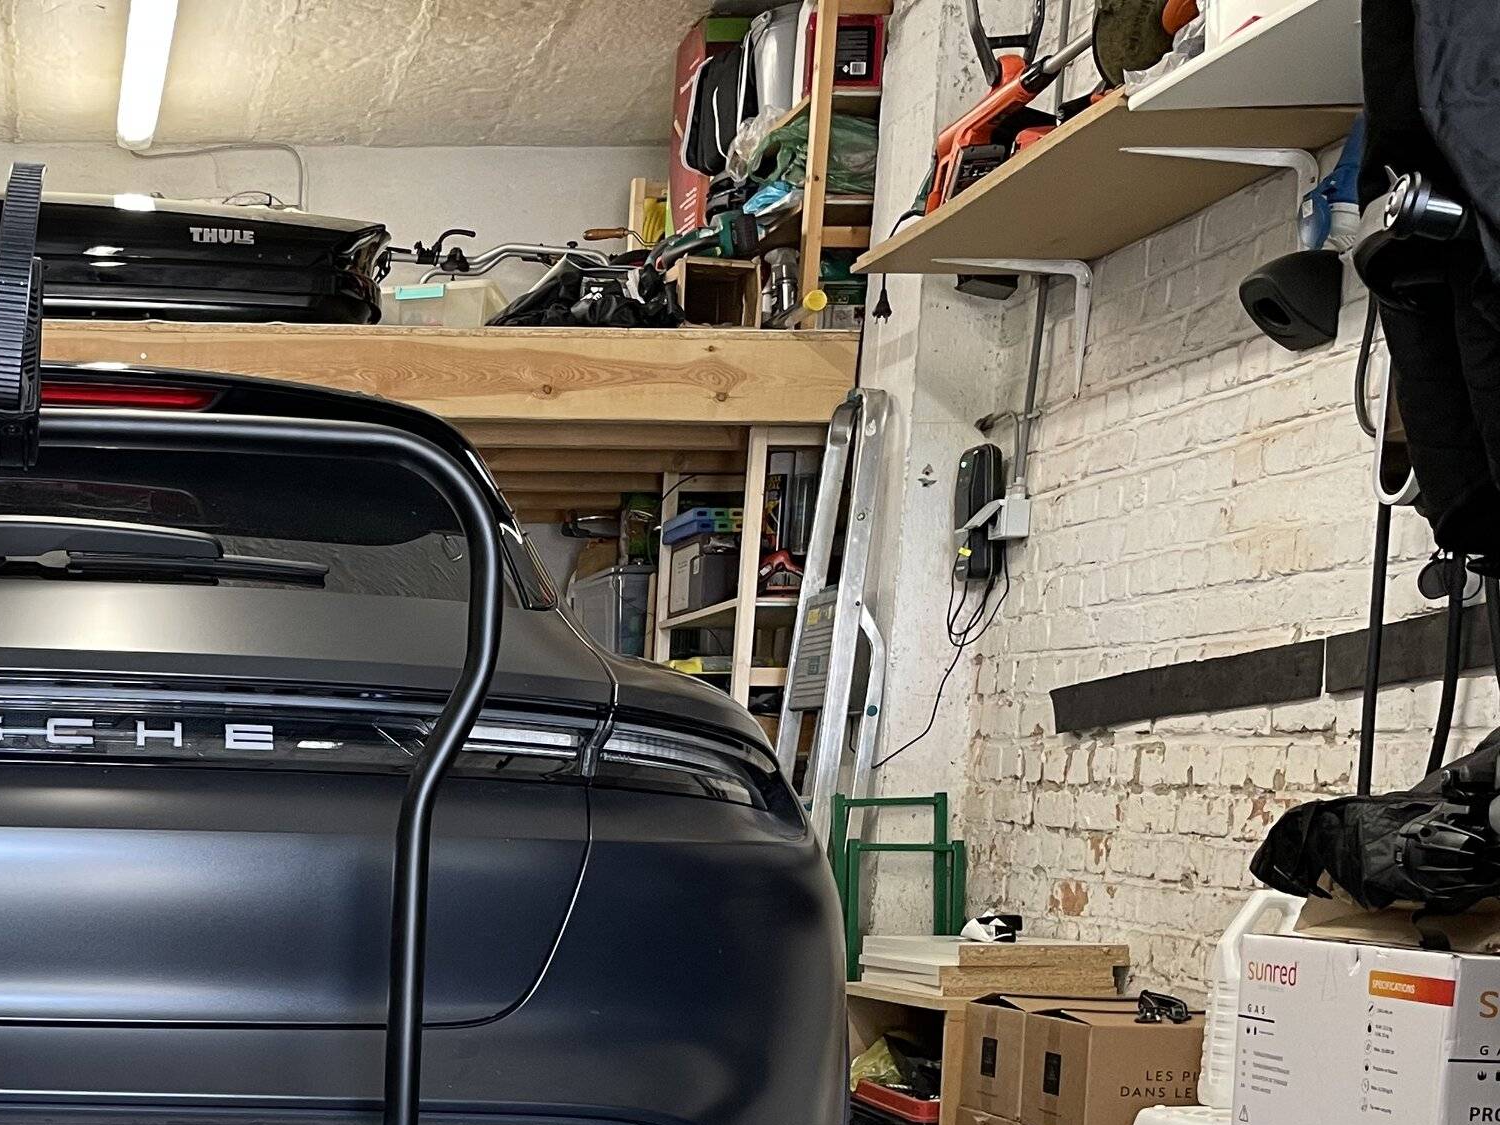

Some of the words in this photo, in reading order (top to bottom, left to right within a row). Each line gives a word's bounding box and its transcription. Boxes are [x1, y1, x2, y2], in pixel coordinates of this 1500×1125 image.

[189, 227, 255, 245] THULE
[1247, 961, 1298, 986] sunred
[1145, 1070, 1173, 1081] LES
[1120, 1086, 1166, 1098] DANS
